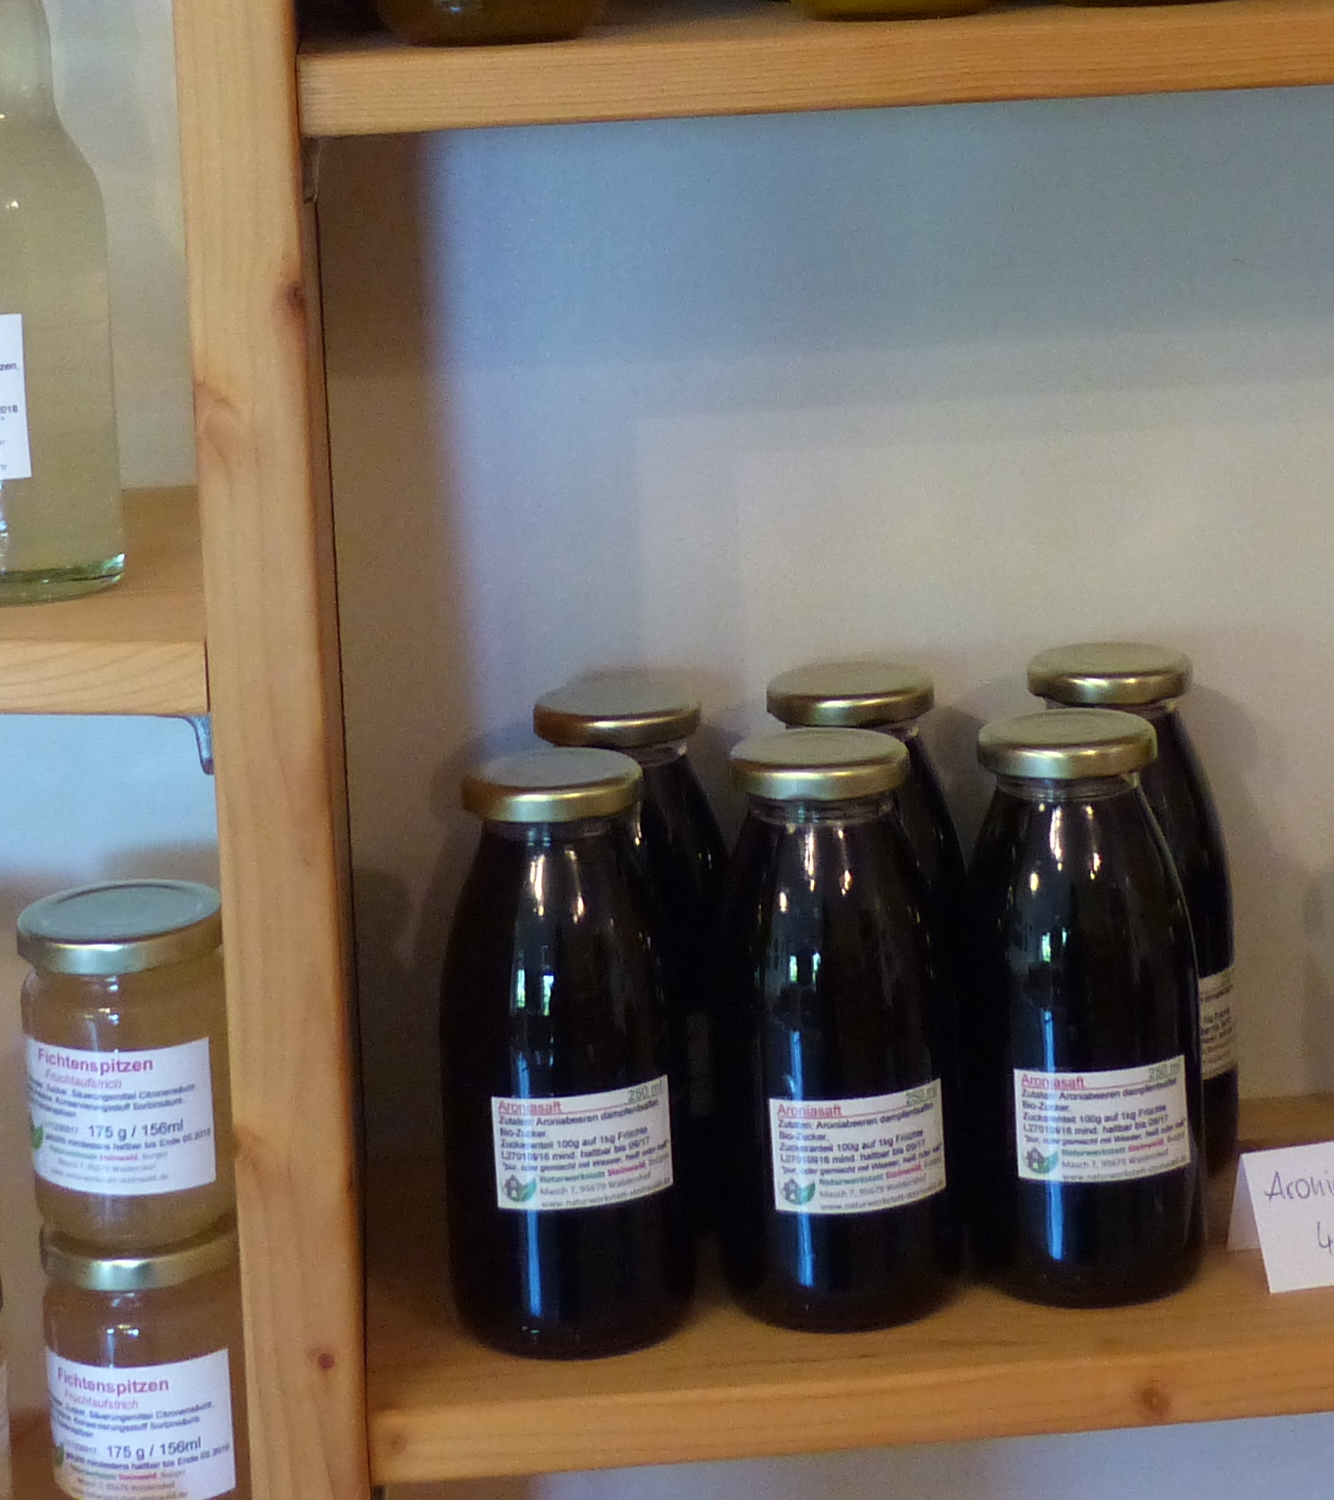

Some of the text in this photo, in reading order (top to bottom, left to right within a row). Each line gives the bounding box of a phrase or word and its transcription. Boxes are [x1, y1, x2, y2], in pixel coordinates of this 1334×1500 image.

[38, 1049, 153, 1075] Fichtenspitzen
[1022, 1074, 1084, 1088] Aronasaft
[778, 1104, 842, 1117] Aroniasaft
[89, 1119, 183, 1140] 175 g 156ml
[58, 1367, 169, 1397] Fichtenspitzen
[107, 1437, 202, 1461] 175 g 156ml
